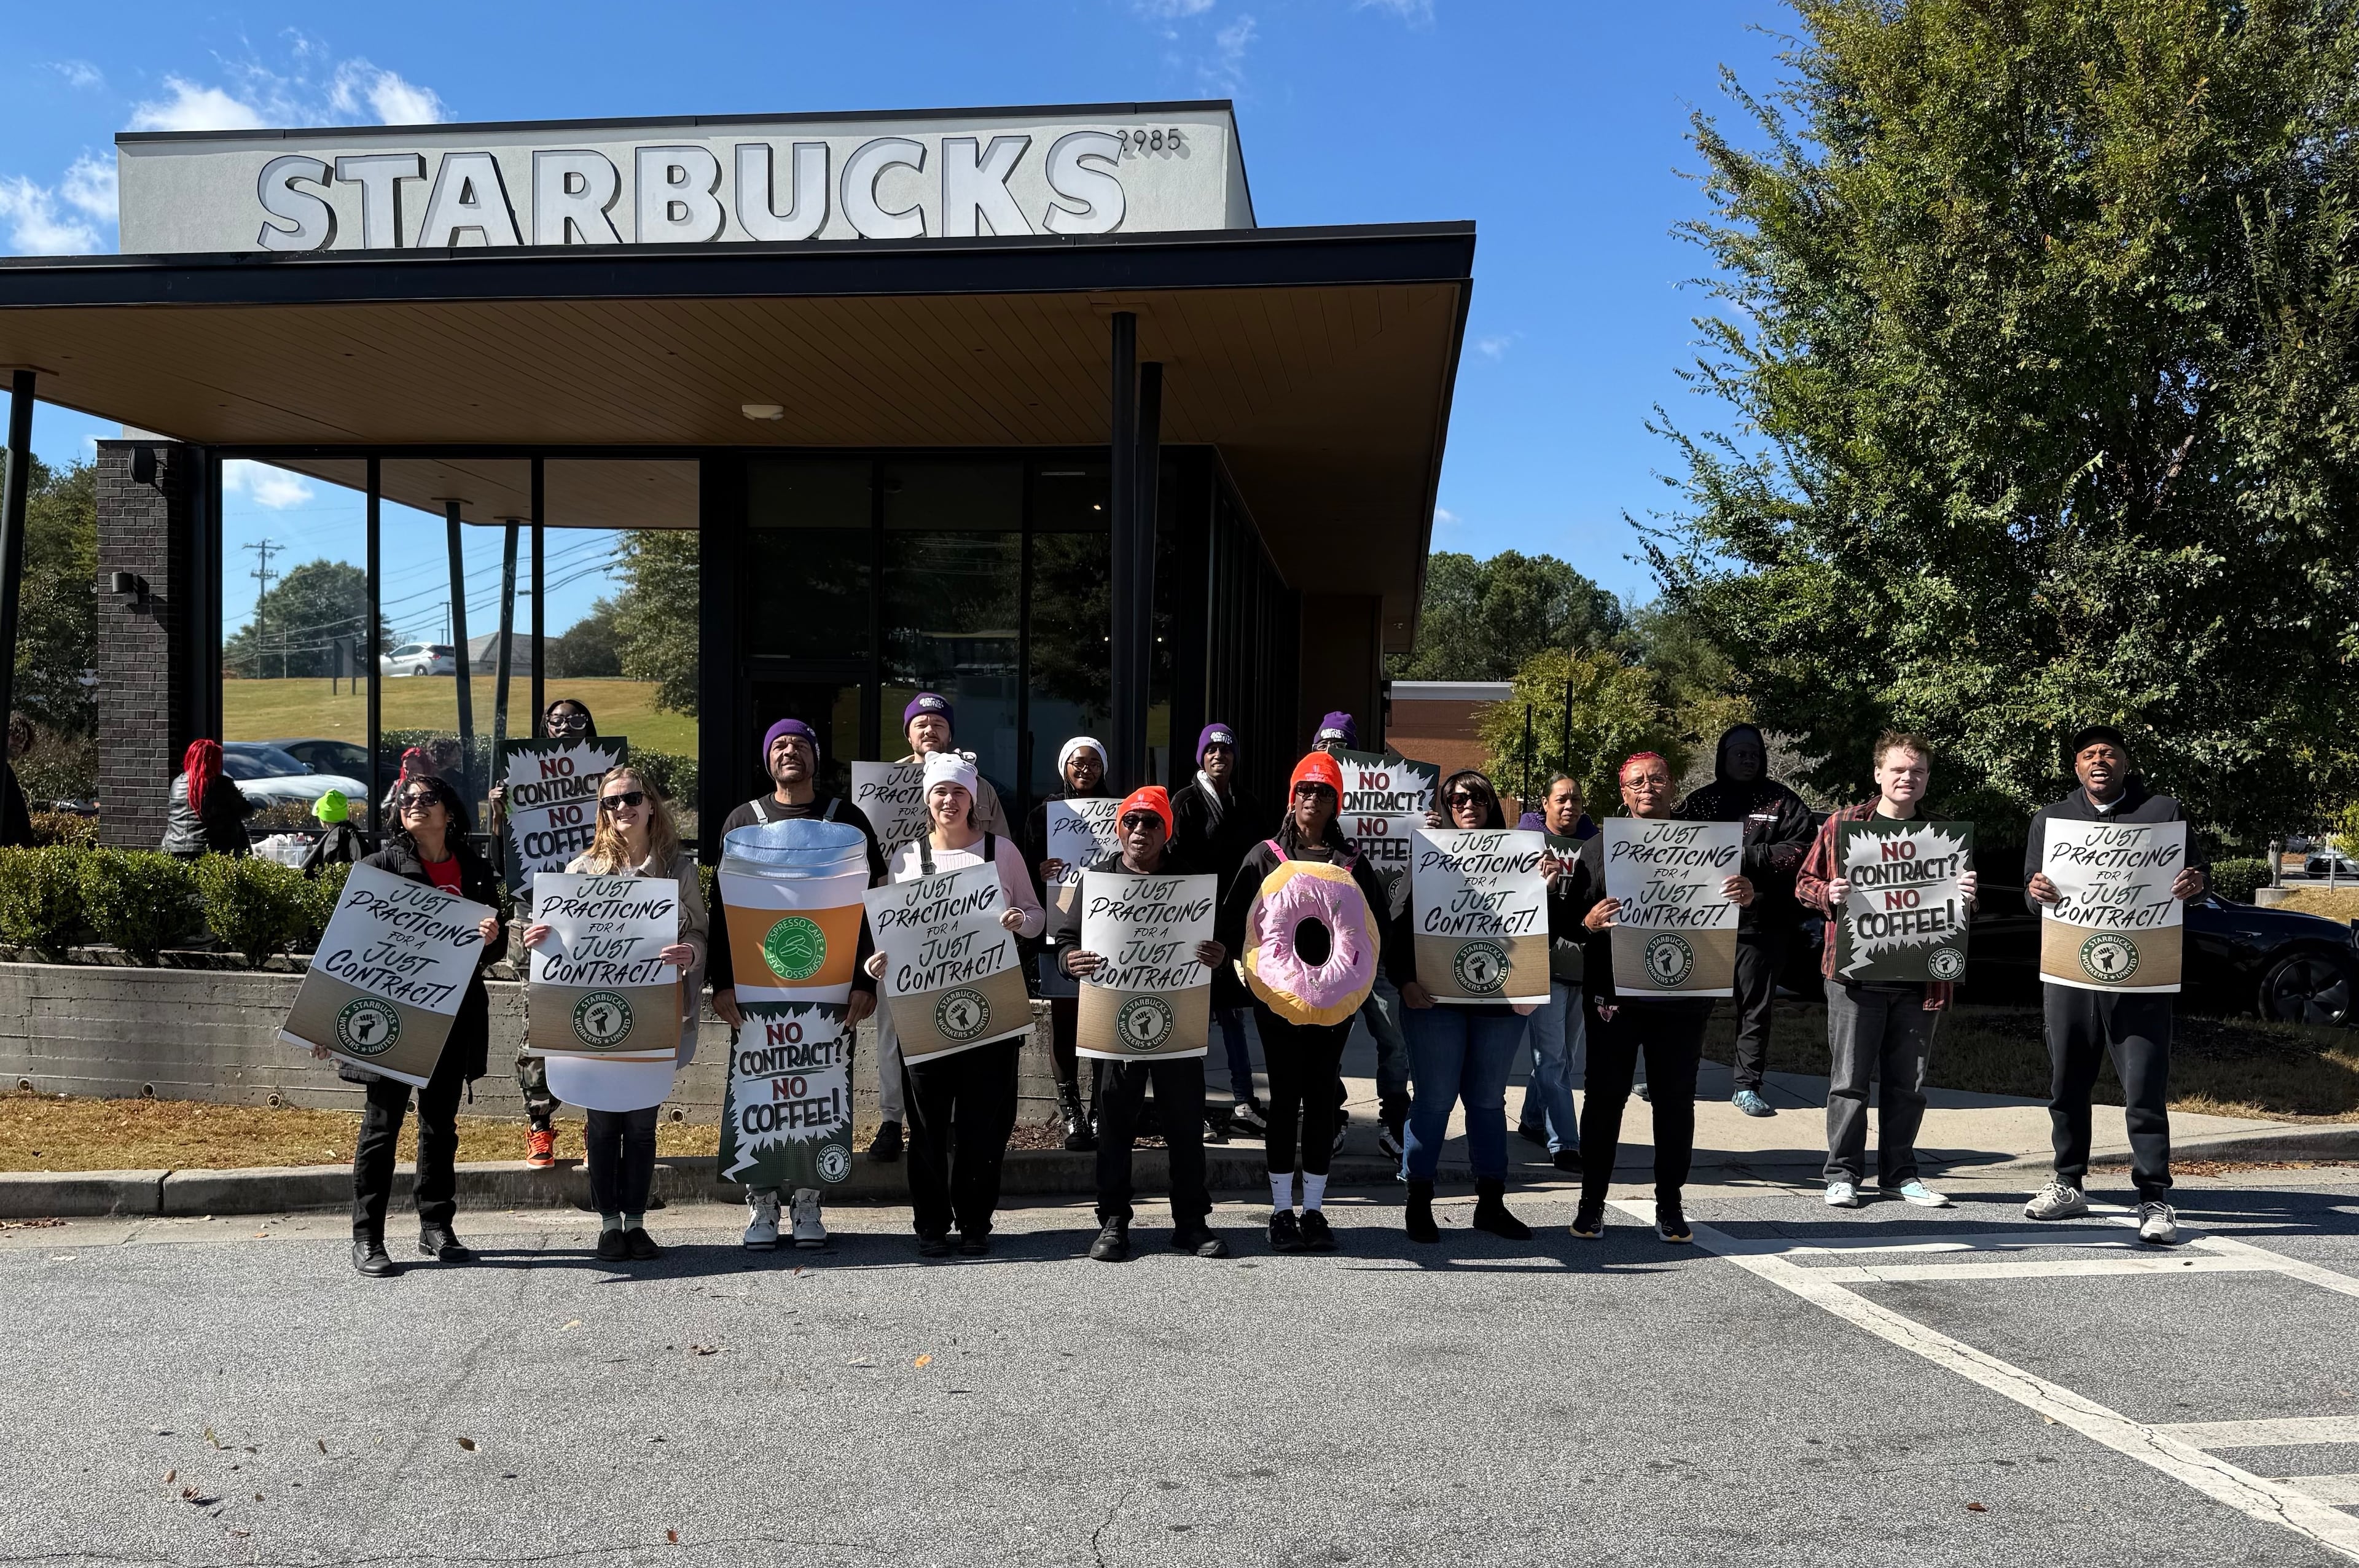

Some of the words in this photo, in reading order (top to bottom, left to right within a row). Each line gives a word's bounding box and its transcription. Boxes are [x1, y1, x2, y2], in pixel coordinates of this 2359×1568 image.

[1117, 128, 1180, 151] 2985
[257, 130, 1126, 251] STARBUCKS
[538, 757, 574, 780] NO
[887, 766, 926, 786] JUS
[1359, 771, 1390, 790] NO
[513, 768, 614, 807] CONTRACT
[858, 783, 923, 804] PRACTI
[898, 807, 918, 816] FOR
[1081, 800, 1124, 819] JUS
[1342, 790, 1426, 811] ONTRACT?
[548, 805, 584, 829] NO
[1053, 817, 1117, 837] PRACTI
[1356, 817, 1388, 836] NO
[523, 824, 597, 859] COFFE
[886, 819, 927, 840] JUS
[1091, 837, 1111, 846] FOR
[1643, 823, 1709, 844] JUST
[2086, 826, 2153, 847] JUST
[1452, 832, 1511, 853] JUST
[1611, 841, 1739, 868] PRACTICING
[1880, 841, 1916, 862] NO
[1079, 848, 1119, 867] JU
[1419, 851, 1542, 874] PRACTICING
[1559, 857, 1574, 875] N
[2050, 843, 2182, 867] PRACTICING
[1464, 876, 1487, 887] FOR
[1489, 876, 1498, 886] A
[1654, 868, 1678, 880] FOR
[1680, 870, 1690, 880] A
[1850, 853, 1959, 887] CONTRACT?
[2096, 871, 2121, 881] FOR
[2124, 871, 2133, 882] A
[390, 883, 461, 915] JUST
[576, 877, 643, 899] JUST
[906, 872, 963, 907] JUST
[1123, 878, 1186, 901] JUST
[1640, 880, 1708, 904] JUST
[1884, 889, 1920, 911] NO
[2081, 883, 2152, 905] JUST
[540, 895, 675, 919] PRACTICING
[878, 884, 998, 935] PRACTICING
[1088, 897, 1213, 924] PRACTICING
[1451, 889, 1516, 913] JUST
[1619, 898, 1731, 928] CONTRACT!
[2054, 896, 2174, 929] CONTRACT!
[345, 891, 483, 947] PRACTICING
[589, 922, 614, 933] FOR
[616, 922, 625, 933] A
[927, 922, 947, 938] FOR
[951, 920, 958, 932] A
[1425, 905, 1539, 935] CONTRACT!
[1857, 899, 1955, 940] COFFEE!
[387, 931, 415, 949] FOR
[417, 940, 427, 950] A
[768, 919, 806, 943] ESPRESSO
[807, 924, 824, 945] CAFE
[1133, 927, 1159, 938] FOR
[1159, 927, 1169, 938] A
[1649, 935, 1688, 951] STARBUCKS
[2088, 936, 2133, 951] STARBUCKS
[362, 941, 440, 976] JUST
[573, 936, 644, 961] JUST
[919, 930, 980, 967] JUST
[1119, 940, 1186, 965] JUST
[1460, 945, 1502, 959] STARBUCKS
[542, 954, 666, 985] CONTRACT!
[767, 953, 784, 973] CAFE
[785, 954, 824, 978] ESPRESSO
[896, 939, 1006, 993] CONTRACT!
[1090, 956, 1202, 989] CONTRACT!
[1646, 958, 1669, 983] WORKERS
[1675, 959, 1692, 981] UNITED
[2081, 954, 2108, 980] WORKERS
[2116, 958, 2137, 978] UNITED
[326, 950, 458, 1008] CONTRACT!
[1455, 966, 1481, 991] WORKERS
[1488, 966, 1508, 989] UNITED
[581, 994, 627, 1010] STARBUCKS
[939, 991, 982, 1010] STARBUCKS
[1126, 998, 1168, 1013] STARBUCKS
[353, 1001, 397, 1025] STARBUCKS
[937, 1018, 968, 1038] WORKERS
[973, 1007, 988, 1032] UNITED
[339, 1016, 360, 1051] WORKERS
[369, 1034, 396, 1053] UNITED
[574, 1017, 602, 1044] WORKERS
[611, 1018, 631, 1042] UNITED
[766, 1022, 804, 1046] NO
[1119, 1021, 1145, 1048] WORKERS
[1152, 1021, 1171, 1045] UNITED
[739, 1037, 843, 1075] CONTRACT?
[772, 1076, 808, 1101] NO
[742, 1087, 842, 1135] COFFEE!
